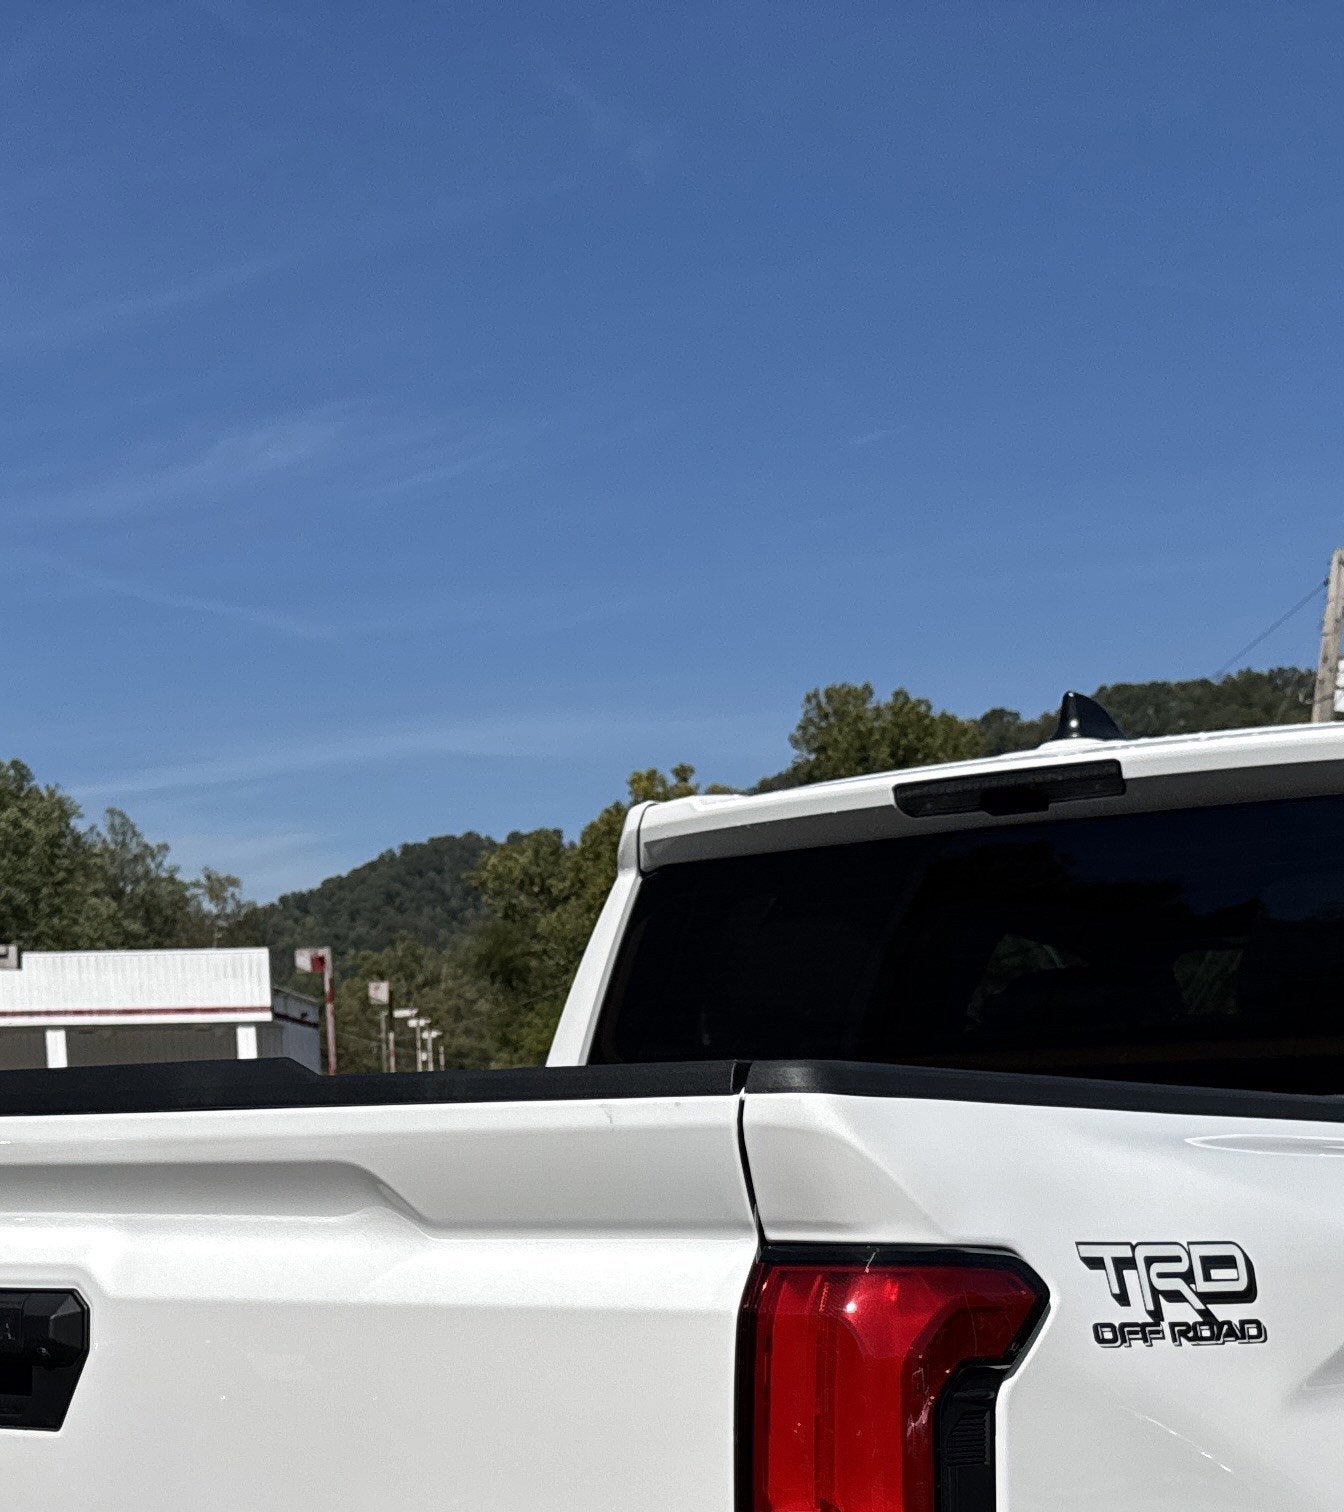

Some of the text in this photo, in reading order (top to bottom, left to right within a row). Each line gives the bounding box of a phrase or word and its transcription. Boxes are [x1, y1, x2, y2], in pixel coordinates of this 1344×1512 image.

[1075, 1241, 1256, 1322] TRD
[1092, 1319, 1267, 1347] OFF ROAD
